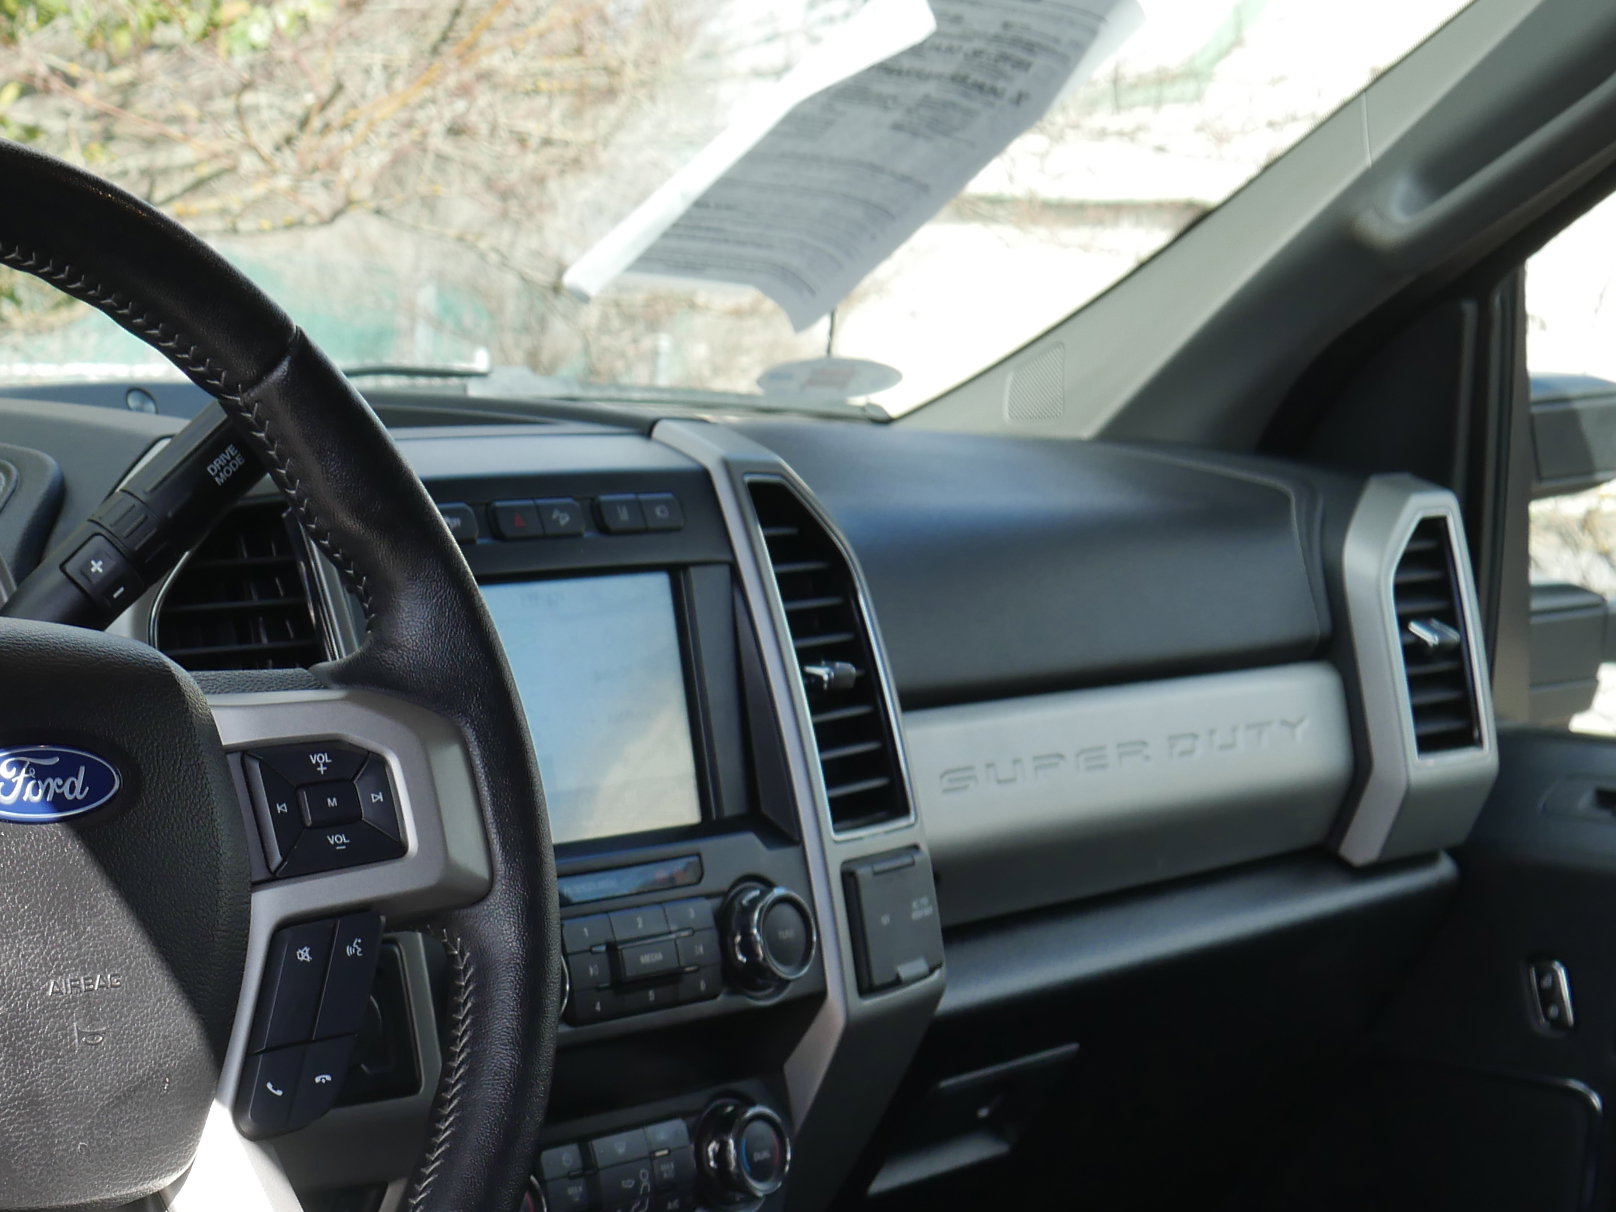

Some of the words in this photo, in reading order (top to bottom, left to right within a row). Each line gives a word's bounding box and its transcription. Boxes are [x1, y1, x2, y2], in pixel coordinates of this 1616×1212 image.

[207, 444, 239, 476] DRIVE
[214, 454, 246, 487] MODE
[309, 752, 333, 765] VOL
[938, 738, 1151, 794] SUPER
[1167, 713, 1310, 760] DUTY
[326, 797, 338, 808] M
[326, 834, 351, 846] VOL
[48, 973, 123, 997] AIRBAG
